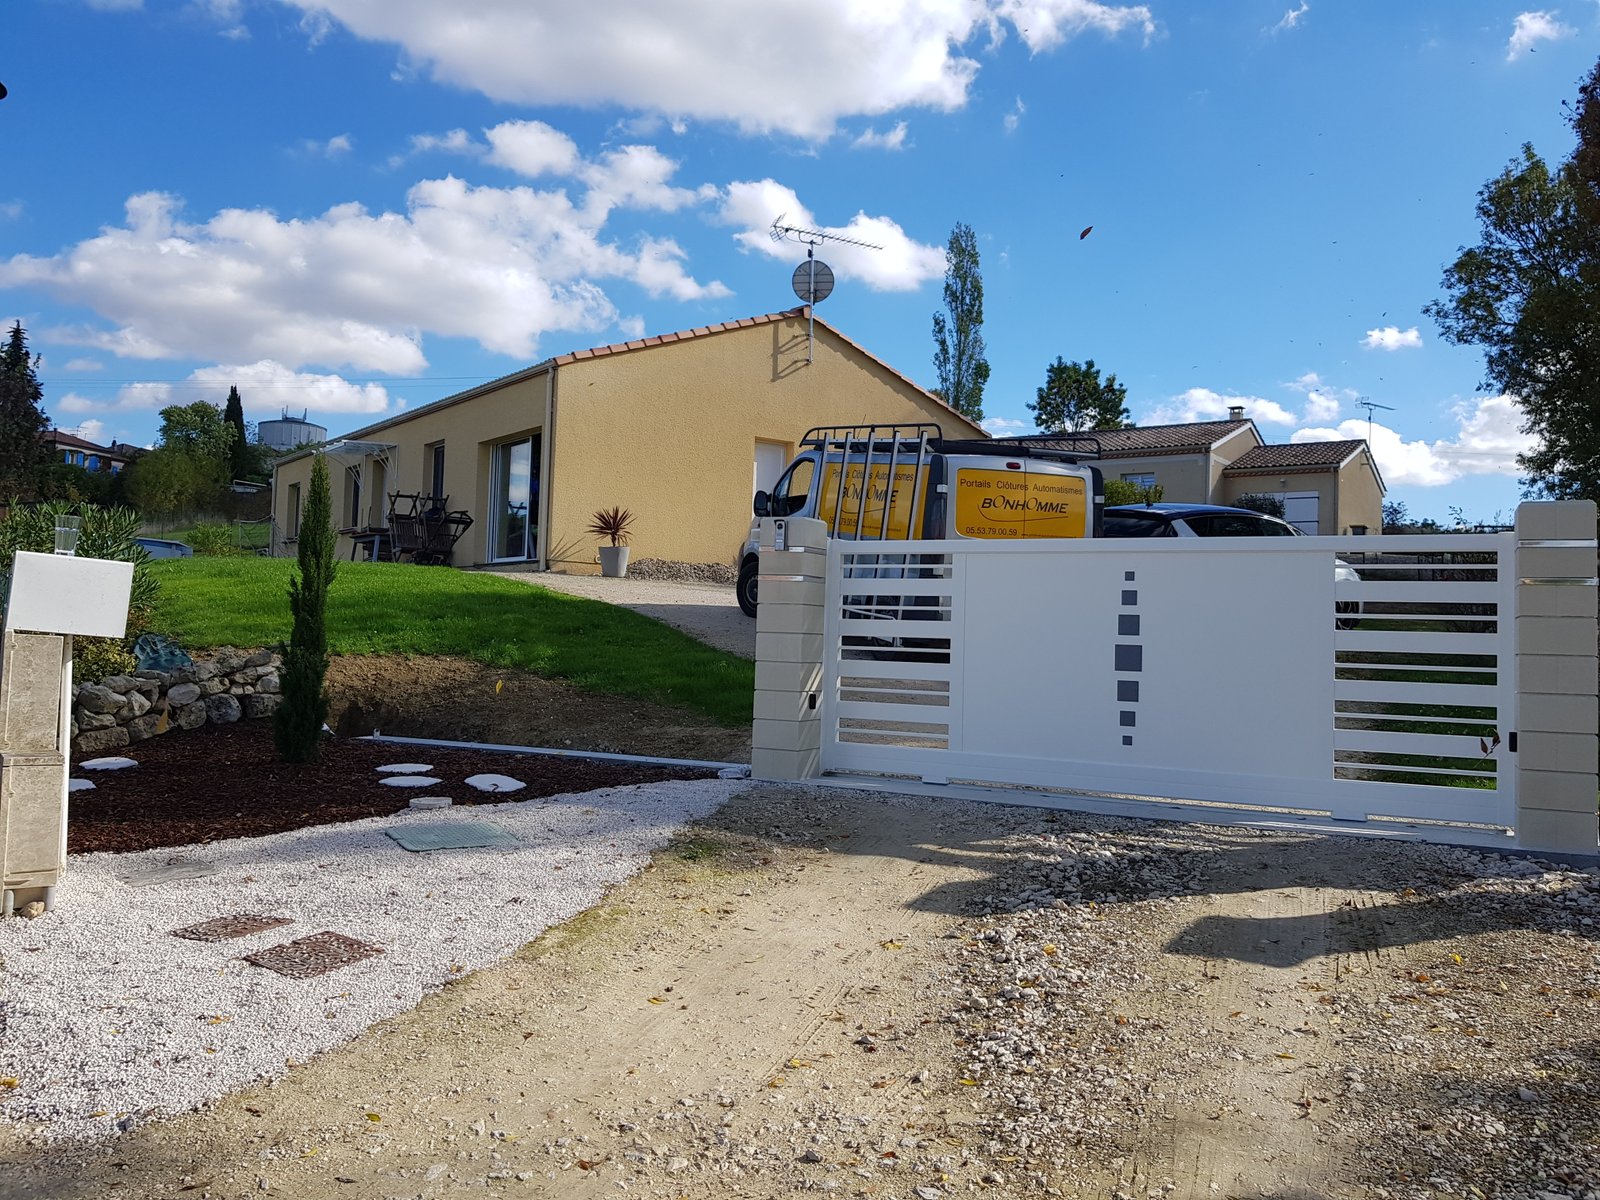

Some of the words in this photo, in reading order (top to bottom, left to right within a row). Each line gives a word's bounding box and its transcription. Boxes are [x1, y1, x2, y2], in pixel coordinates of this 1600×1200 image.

[960, 478, 991, 489] Portails
[996, 480, 1029, 492] Clôtures
[1032, 483, 1083, 496] Automatismes
[981, 494, 1069, 514] BONHOMME
[965, 526, 1018, 537] 05.53.79.00.59
